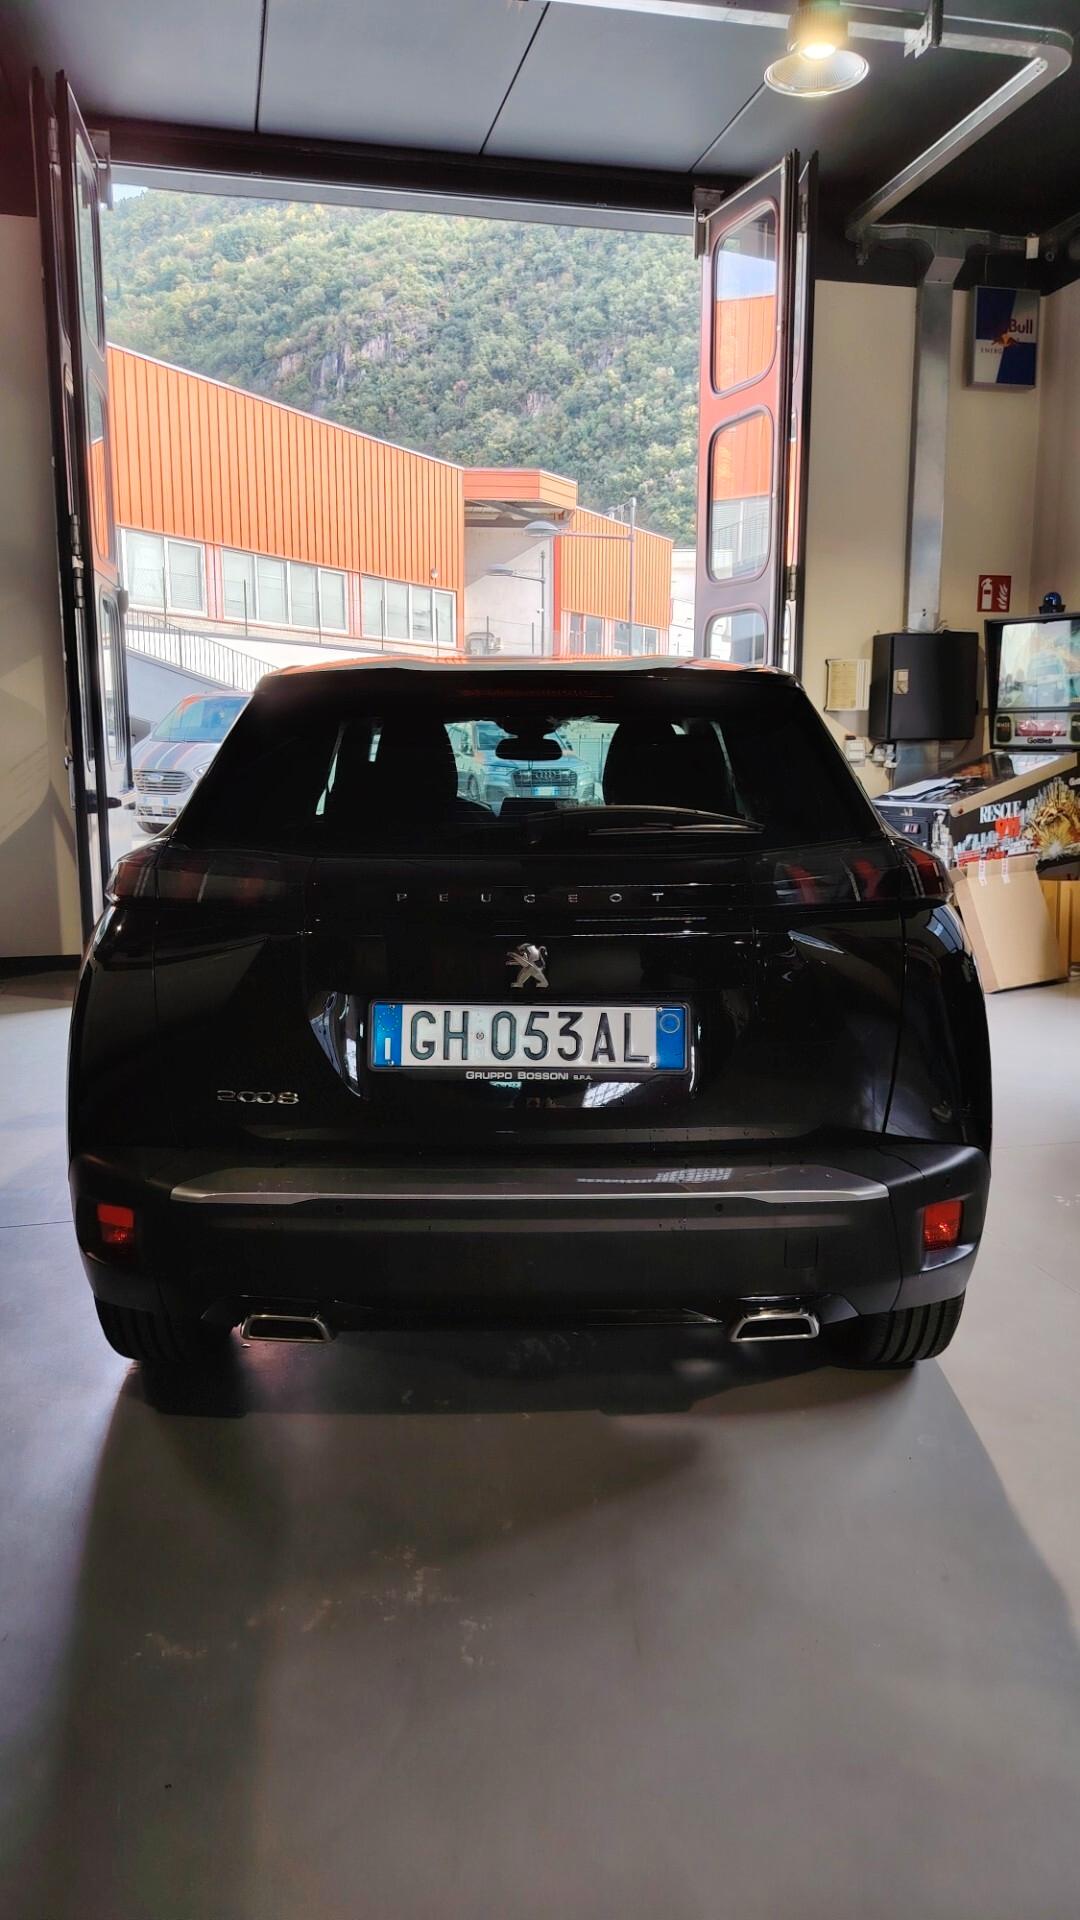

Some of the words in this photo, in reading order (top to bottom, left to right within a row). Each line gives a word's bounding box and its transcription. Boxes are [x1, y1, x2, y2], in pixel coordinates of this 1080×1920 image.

[1008, 319, 1033, 334] Bull
[980, 801, 1022, 823] RESCUE
[397, 893, 664, 903] PEUGEOT
[410, 1011, 469, 1060] GH
[465, 1071, 512, 1080] GRUPPO
[517, 1071, 568, 1080] BOSSONI
[217, 1090, 299, 1104] 2008
